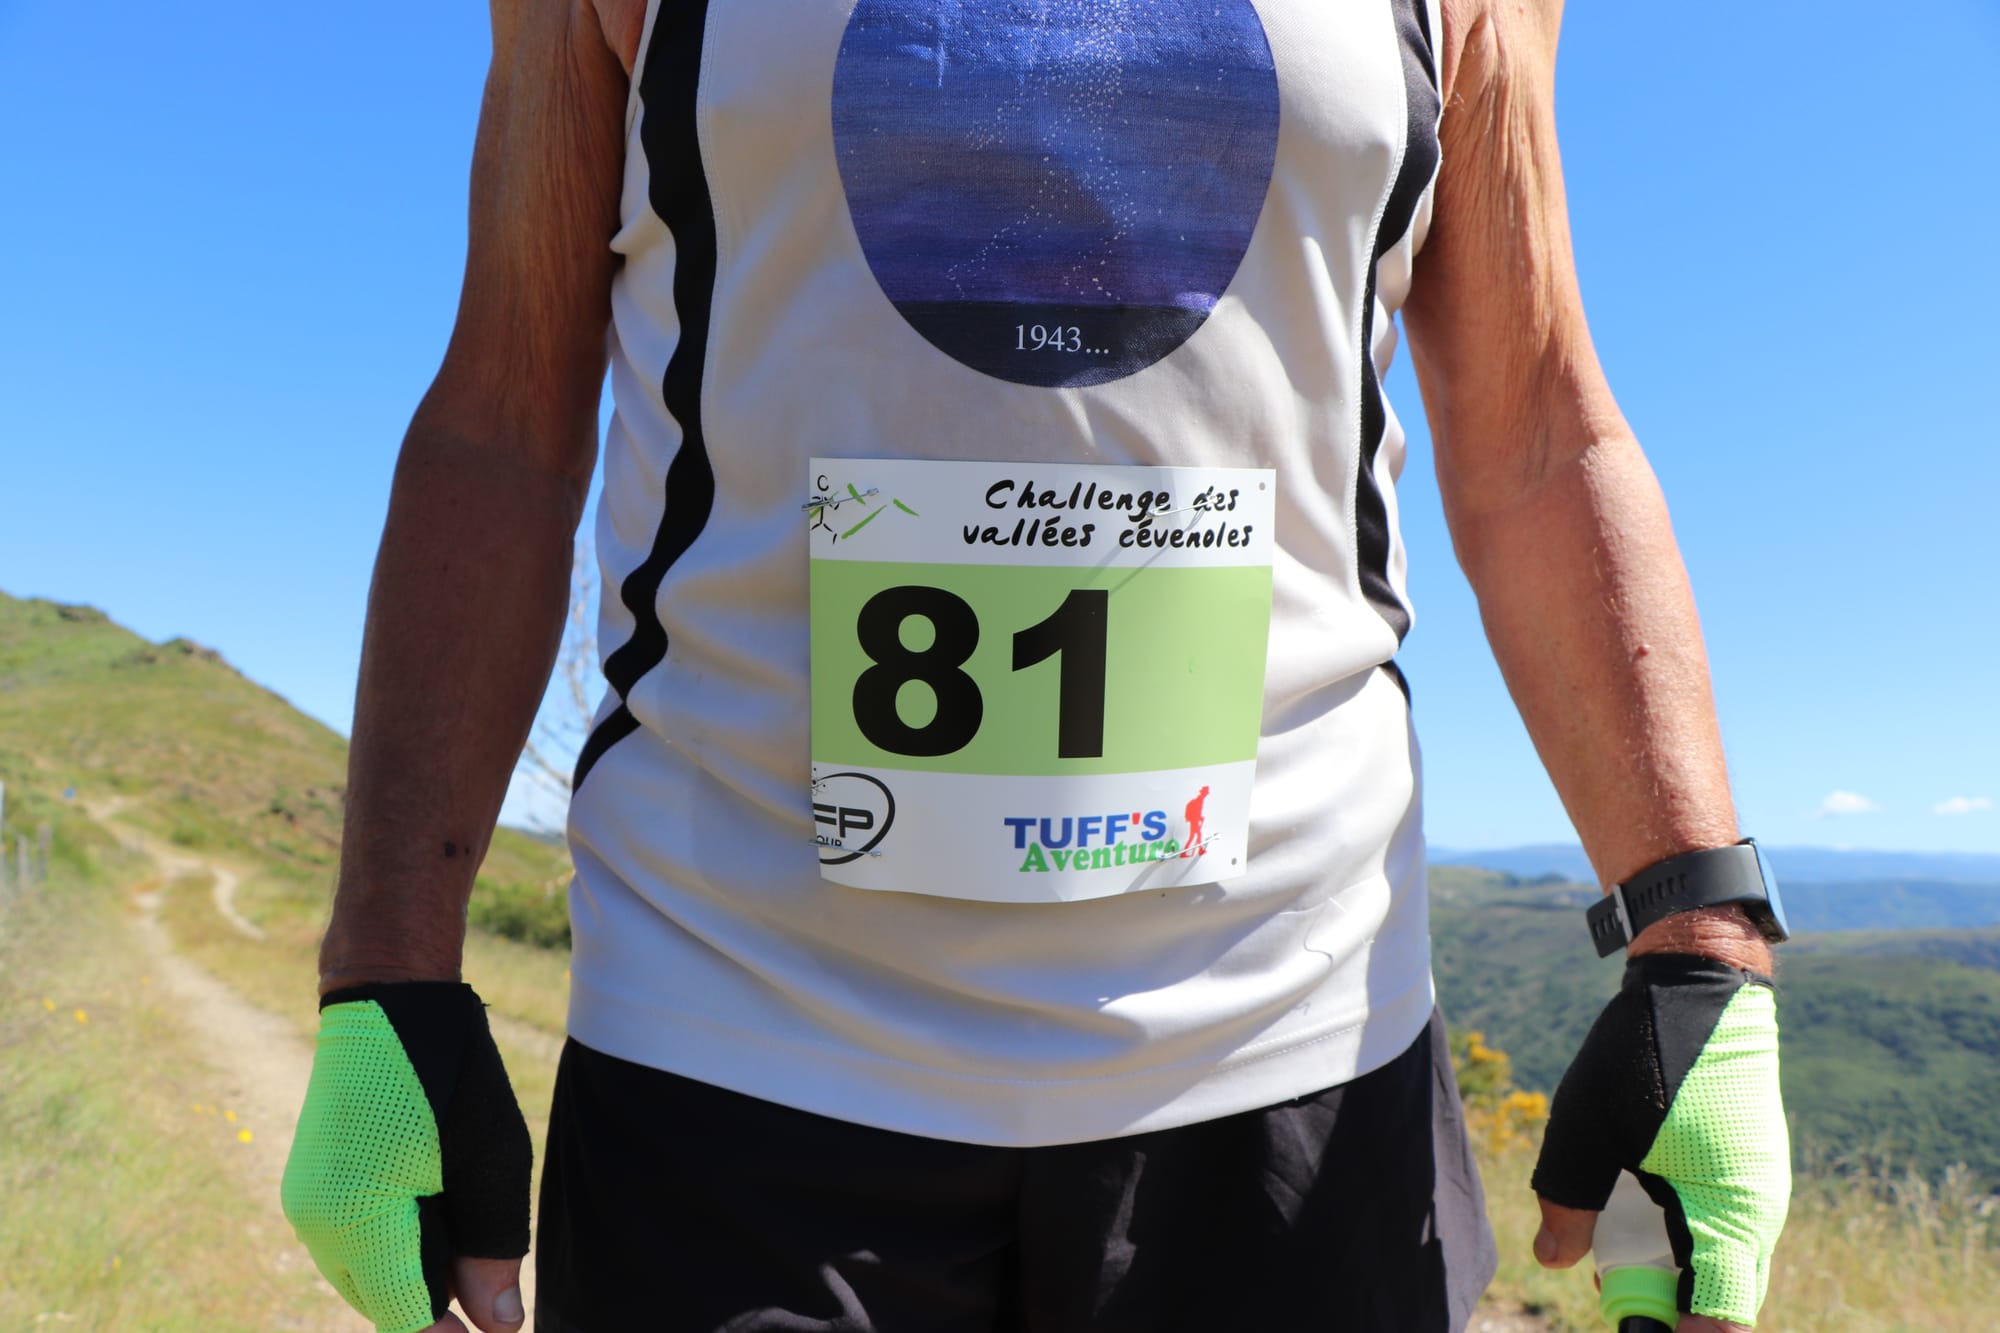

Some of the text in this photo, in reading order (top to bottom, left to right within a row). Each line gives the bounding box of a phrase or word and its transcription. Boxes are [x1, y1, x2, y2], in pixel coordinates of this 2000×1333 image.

[1015, 323, 1110, 354] 1943...
[984, 479, 1240, 522] Challenge des
[962, 514, 1254, 549] vallées cévenoles
[852, 585, 1109, 758] 81
[1003, 809, 1168, 850] TUFF'S
